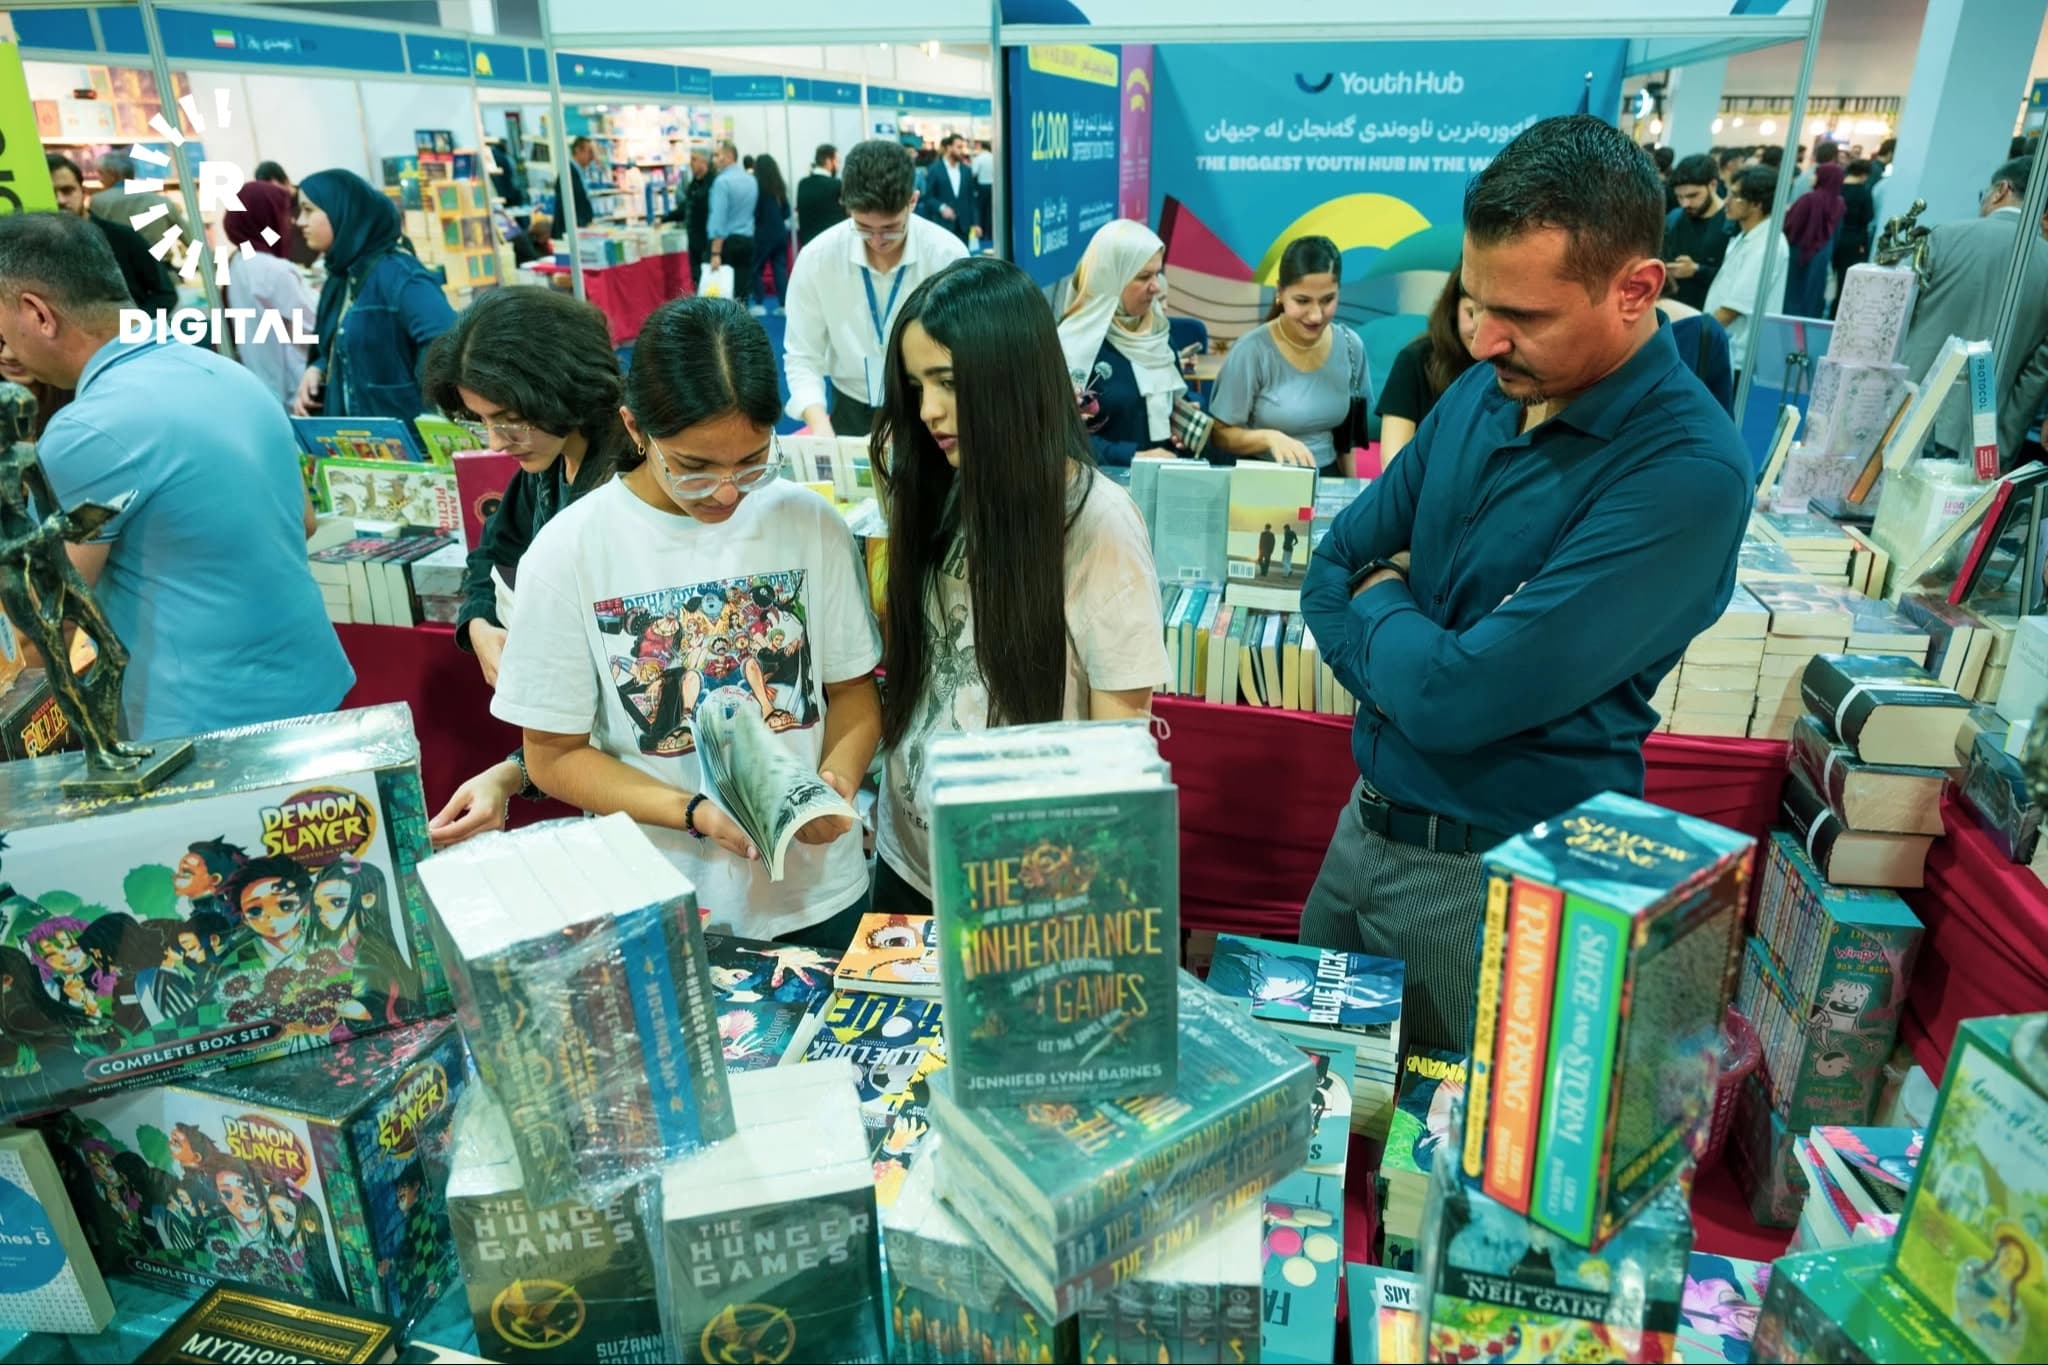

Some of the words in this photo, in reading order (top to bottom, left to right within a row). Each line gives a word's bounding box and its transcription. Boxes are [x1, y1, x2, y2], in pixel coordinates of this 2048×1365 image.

[1197, 155, 1226, 170] THE
[1228, 155, 1303, 171] BIGGEST
[1306, 156, 1365, 171] YOUTH
[1368, 156, 1402, 171] HUB
[1409, 156, 1429, 171] IN
[1432, 156, 1465, 171] THE
[1978, 358, 1988, 409] PROTOCOL
[262, 793, 357, 832] DEMON
[262, 816, 368, 857] SLAYER
[963, 857, 1020, 909] THE
[971, 907, 1162, 976] INHERITANCE
[1316, 950, 1348, 989] LOCK
[1572, 923, 1607, 1012] SIEGE
[687, 976, 709, 1033] HUNGER
[1055, 973, 1148, 1023] GAMES
[1310, 987, 1342, 1024] BLUE
[99, 1043, 195, 1075] COMPLETE
[200, 1035, 237, 1052] BOX
[241, 1025, 271, 1042] SET
[697, 1033, 715, 1078] GAMES
[807, 1040, 868, 1063] LOCK
[967, 1072, 1046, 1090] JENNIFER
[1050, 1069, 1094, 1084] LYNN
[1098, 1064, 1163, 1081] BARNES
[1558, 1043, 1594, 1145] STORM
[376, 1065, 435, 1132] DEMON
[223, 1115, 294, 1149] DEMON
[379, 1084, 441, 1155] SLAYER
[227, 1137, 304, 1171] SLAYER
[480, 1199, 524, 1215] THE
[35, 1231, 50, 1245] 5
[478, 1222, 635, 1261] GAMES
[690, 1213, 869, 1263] HUNGER
[699, 1219, 743, 1238] THE
[693, 1241, 849, 1287] GAMES
[1111, 1247, 1142, 1288] THE
[1153, 1214, 1200, 1262] FINAL
[135, 1261, 197, 1284] COMPLETE
[1384, 1284, 1411, 1305] SPY
[1467, 1281, 1527, 1307] NEIL
